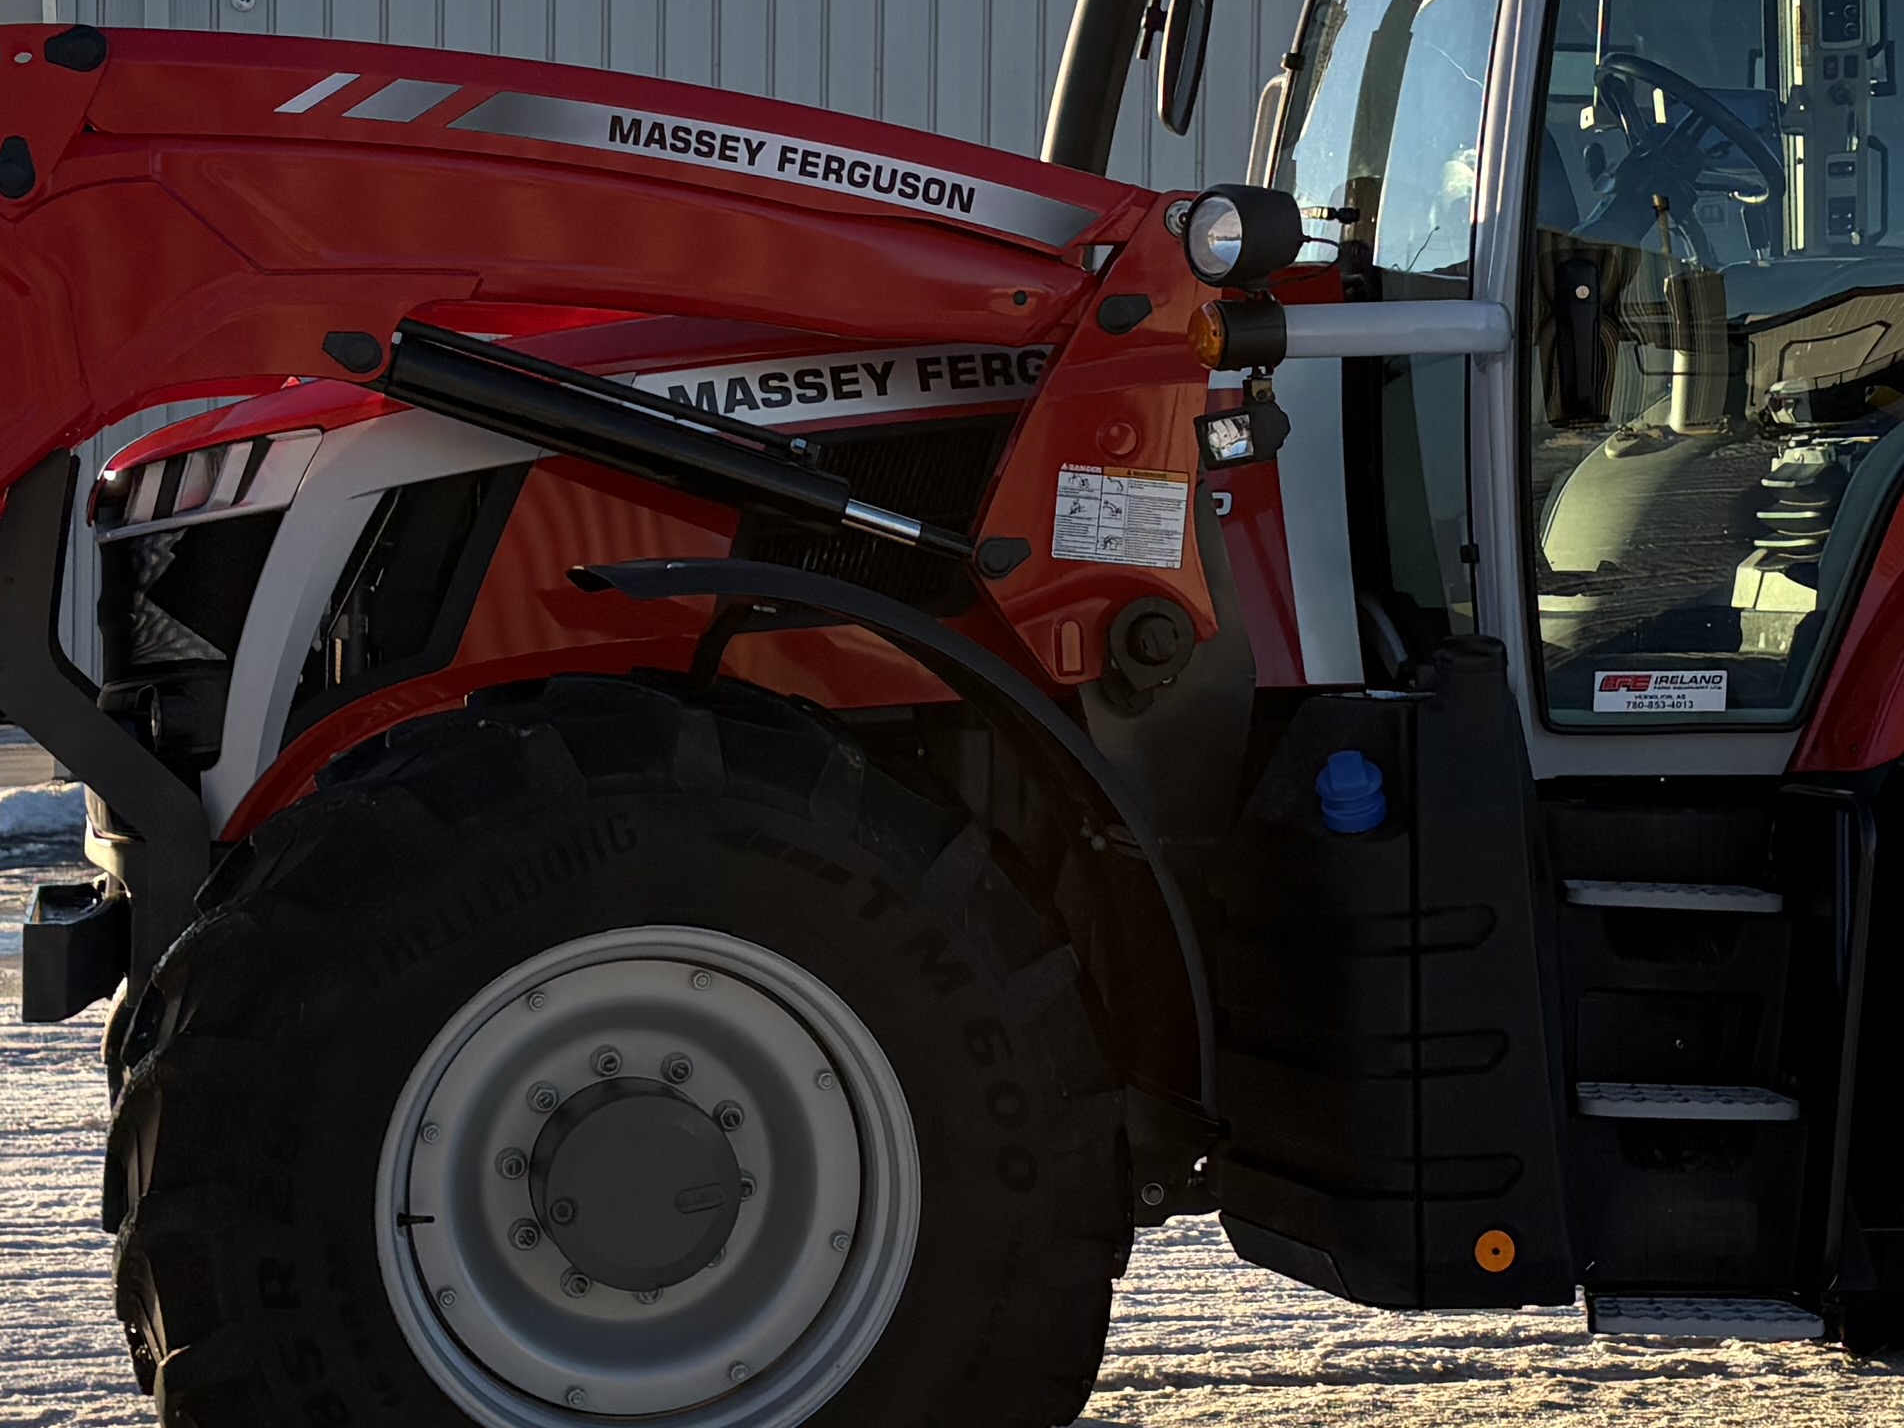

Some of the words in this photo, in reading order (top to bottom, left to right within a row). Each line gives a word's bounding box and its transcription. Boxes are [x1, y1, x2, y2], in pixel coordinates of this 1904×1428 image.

[609, 115, 767, 166] MASSEY
[777, 146, 975, 214] FERGUSON
[668, 360, 895, 415] MASSEY
[1654, 675, 1723, 685] IRELAND
[963, 1018, 1039, 1195] 600
